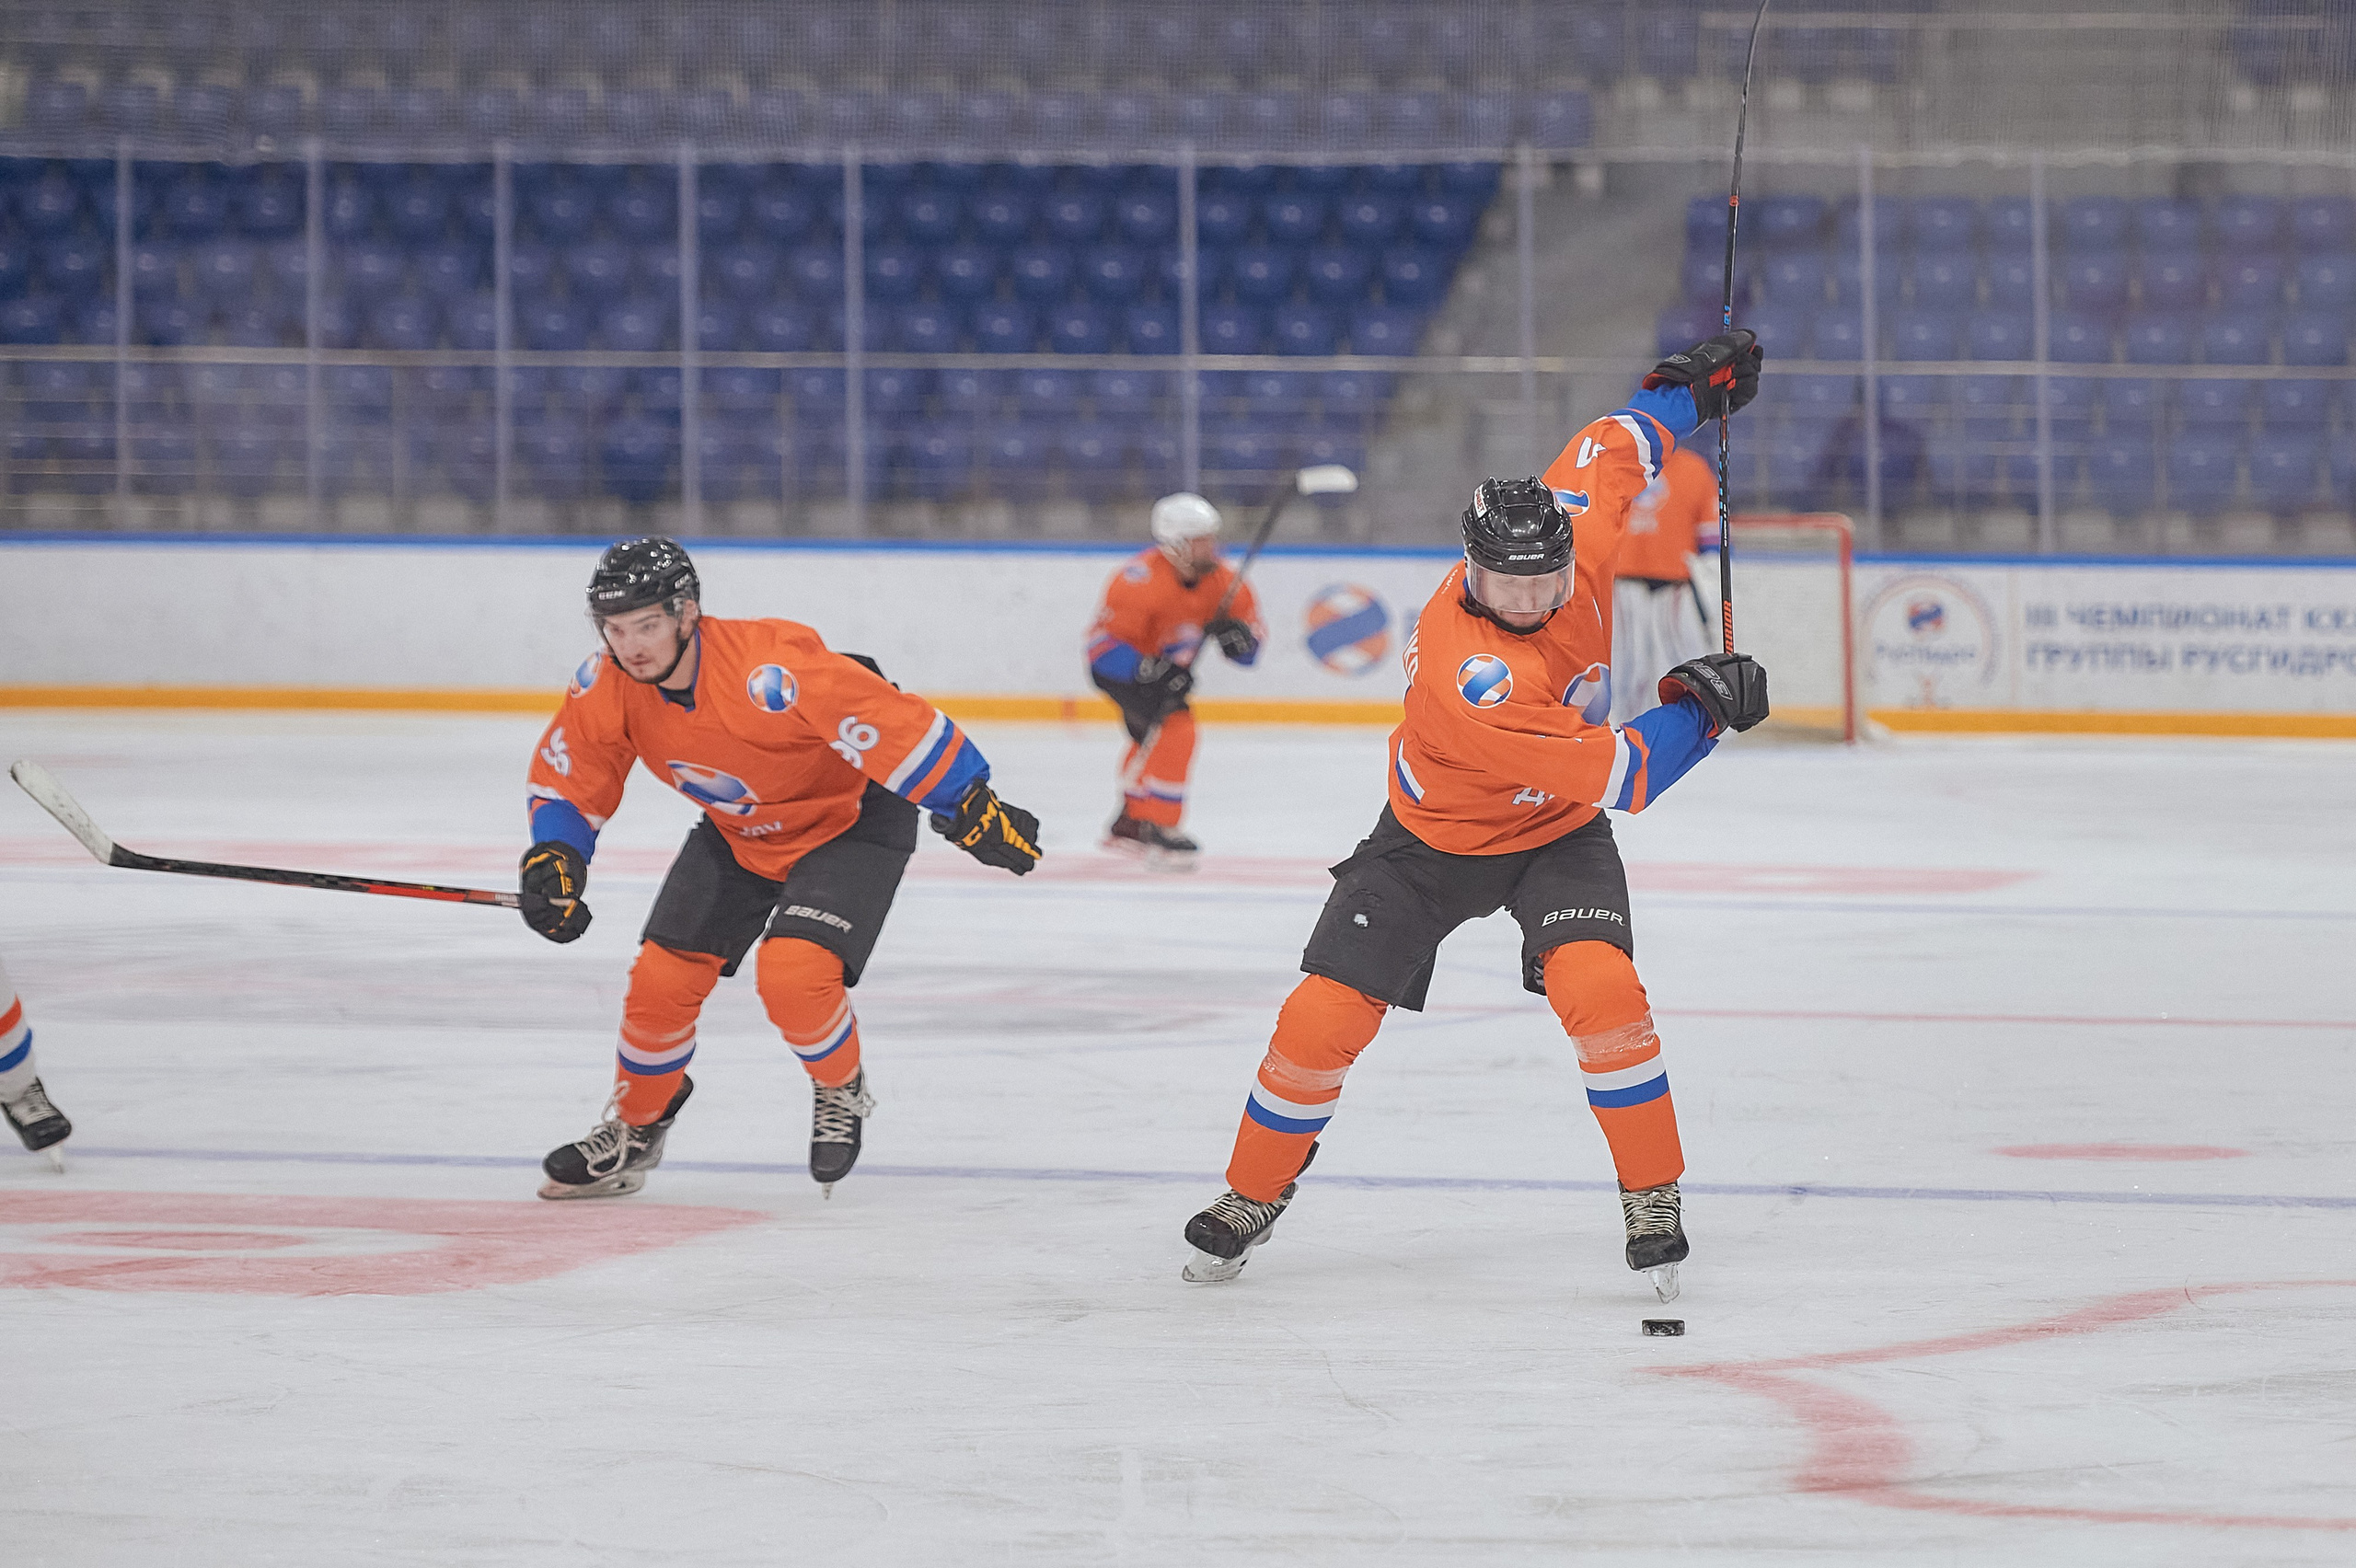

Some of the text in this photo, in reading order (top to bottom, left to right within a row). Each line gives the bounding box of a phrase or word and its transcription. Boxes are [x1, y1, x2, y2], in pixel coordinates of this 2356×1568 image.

[1507, 553, 1545, 561] BAUER
[2067, 605, 2291, 631] ЧЕМПИОНАТ
[2026, 645, 2174, 673] ГРУППЫ
[783, 905, 854, 933] BAUER
[1542, 907, 1626, 927] BAUER
